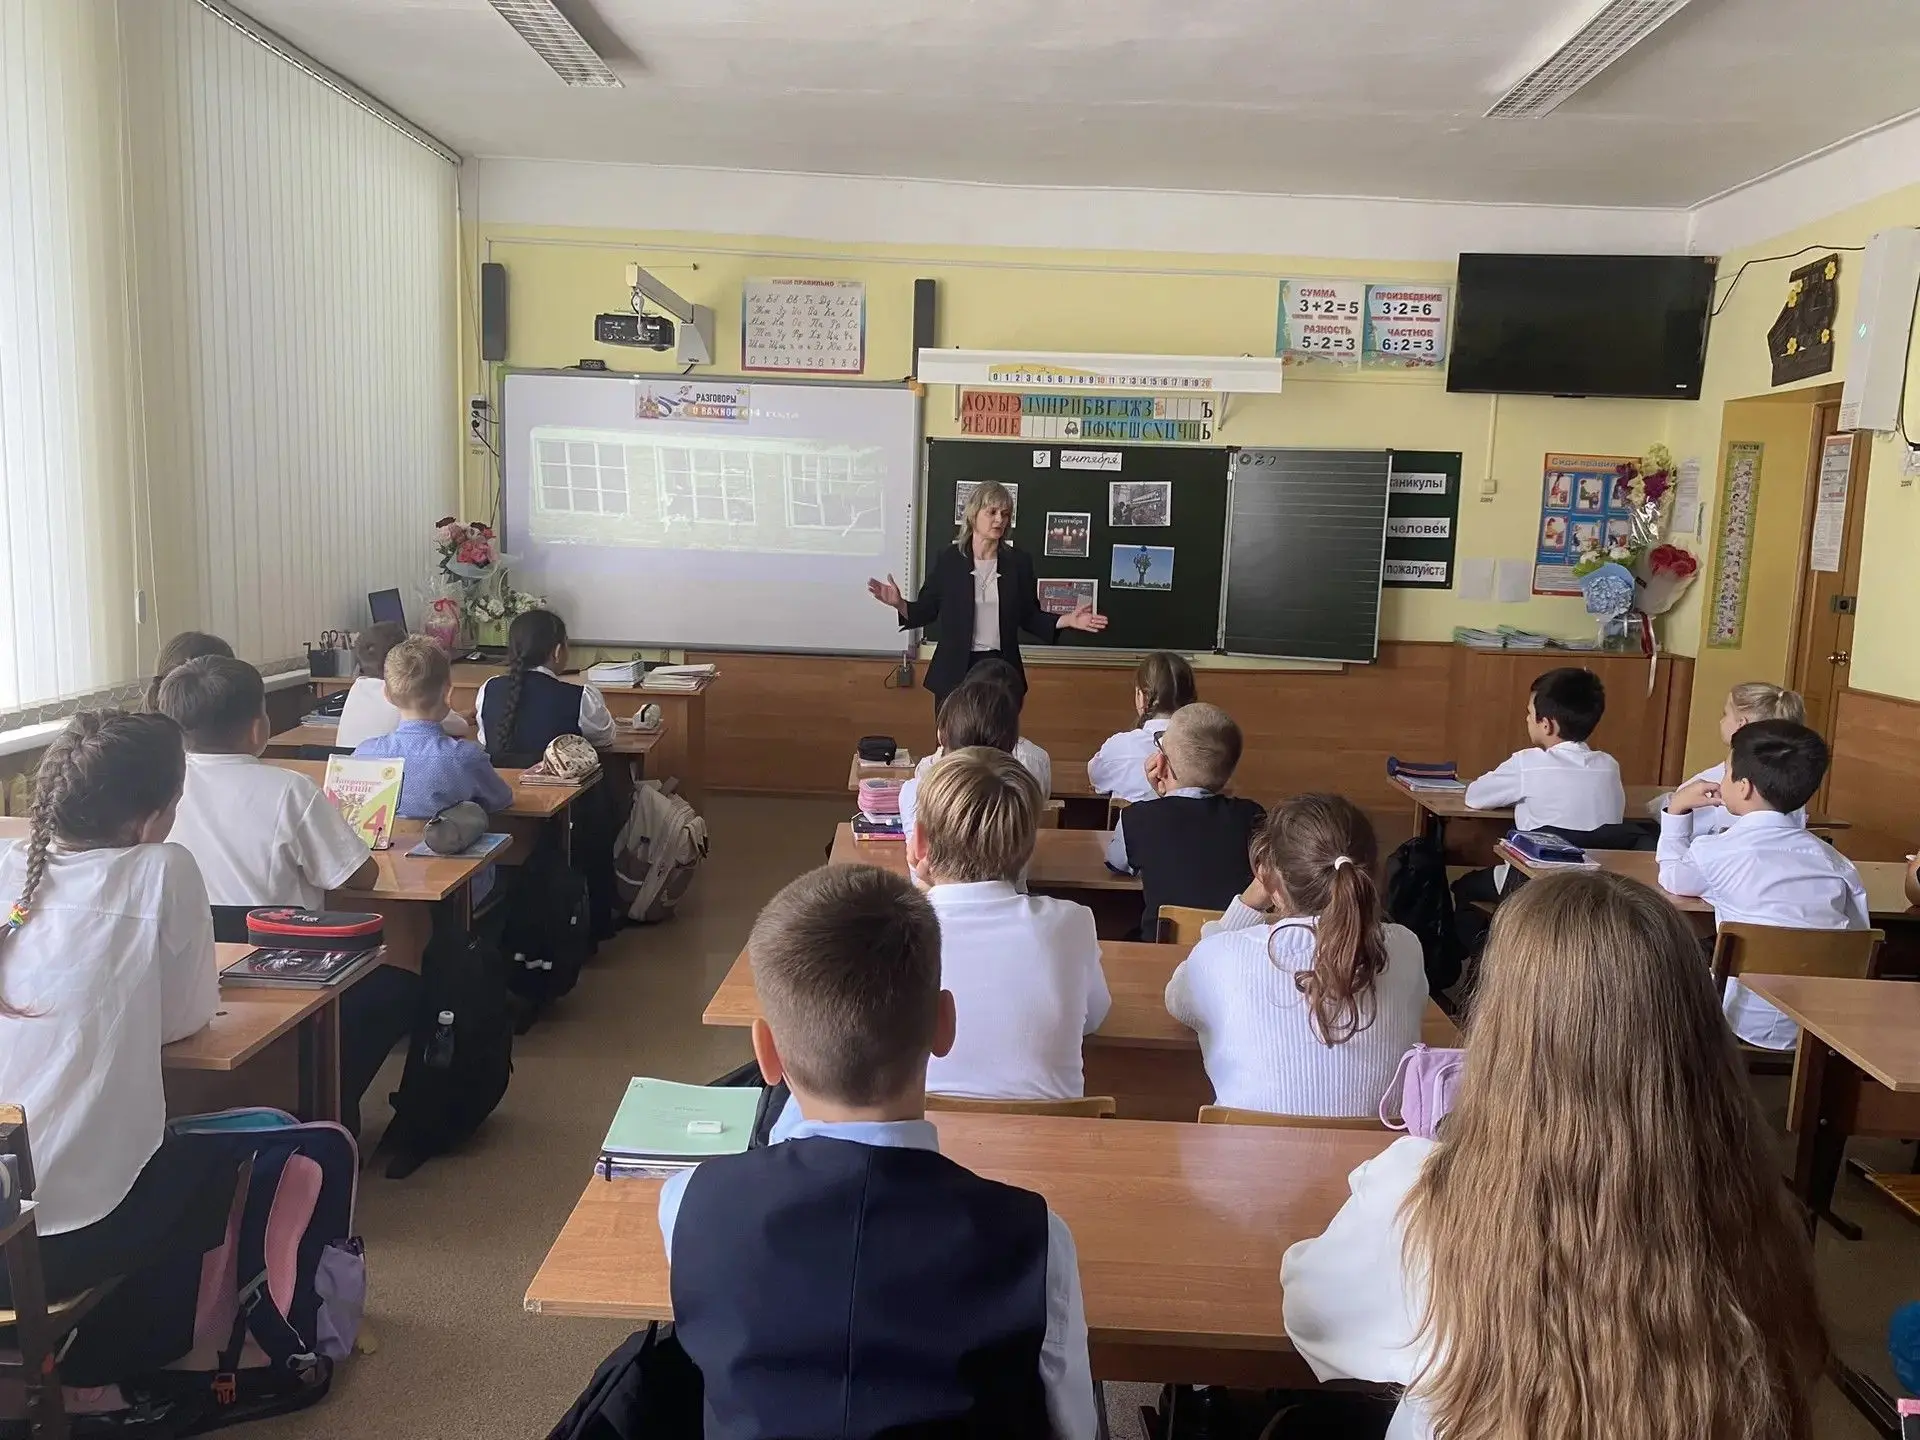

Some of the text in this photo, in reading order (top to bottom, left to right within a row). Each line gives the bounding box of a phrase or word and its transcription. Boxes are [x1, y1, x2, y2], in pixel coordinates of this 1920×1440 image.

[794, 279, 834, 287] ПРАВИЛЬНО
[1300, 289, 1336, 298] СУММА
[1375, 292, 1442, 302] ПРОИЗВЕДЕНИЕ
[1304, 325, 1352, 335] РАЗНОСТЬ
[1387, 329, 1434, 337] ЧАСТНОЕ
[1129, 377, 1136, 385] 13
[1140, 377, 1146, 385] 14
[1171, 378, 1178, 386] 17
[1191, 379, 1198, 387] 19
[1201, 379, 1209, 387] 20
[696, 393, 736, 403] РАЗГОВОРЫ
[1036, 452, 1045, 464] 3
[363, 804, 387, 835] 4
